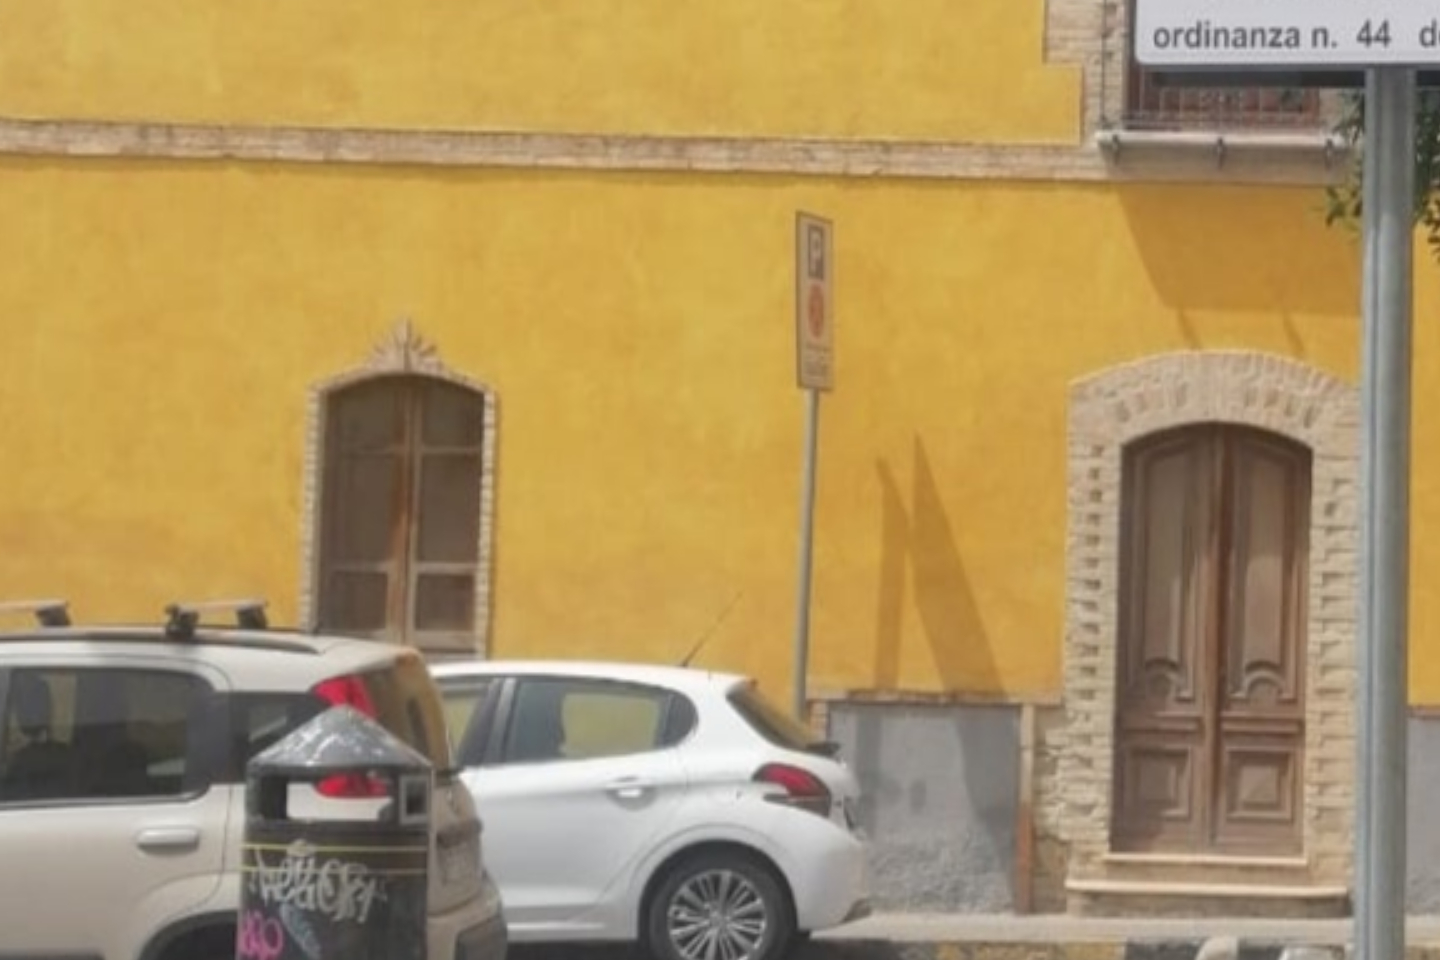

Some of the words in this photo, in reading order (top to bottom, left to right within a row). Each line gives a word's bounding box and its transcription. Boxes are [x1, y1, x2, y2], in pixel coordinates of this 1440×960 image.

[1153, 20, 1300, 49] ordinanza
[1311, 27, 1338, 49] n.
[1356, 19, 1392, 48] 44
[810, 230, 822, 274] P
